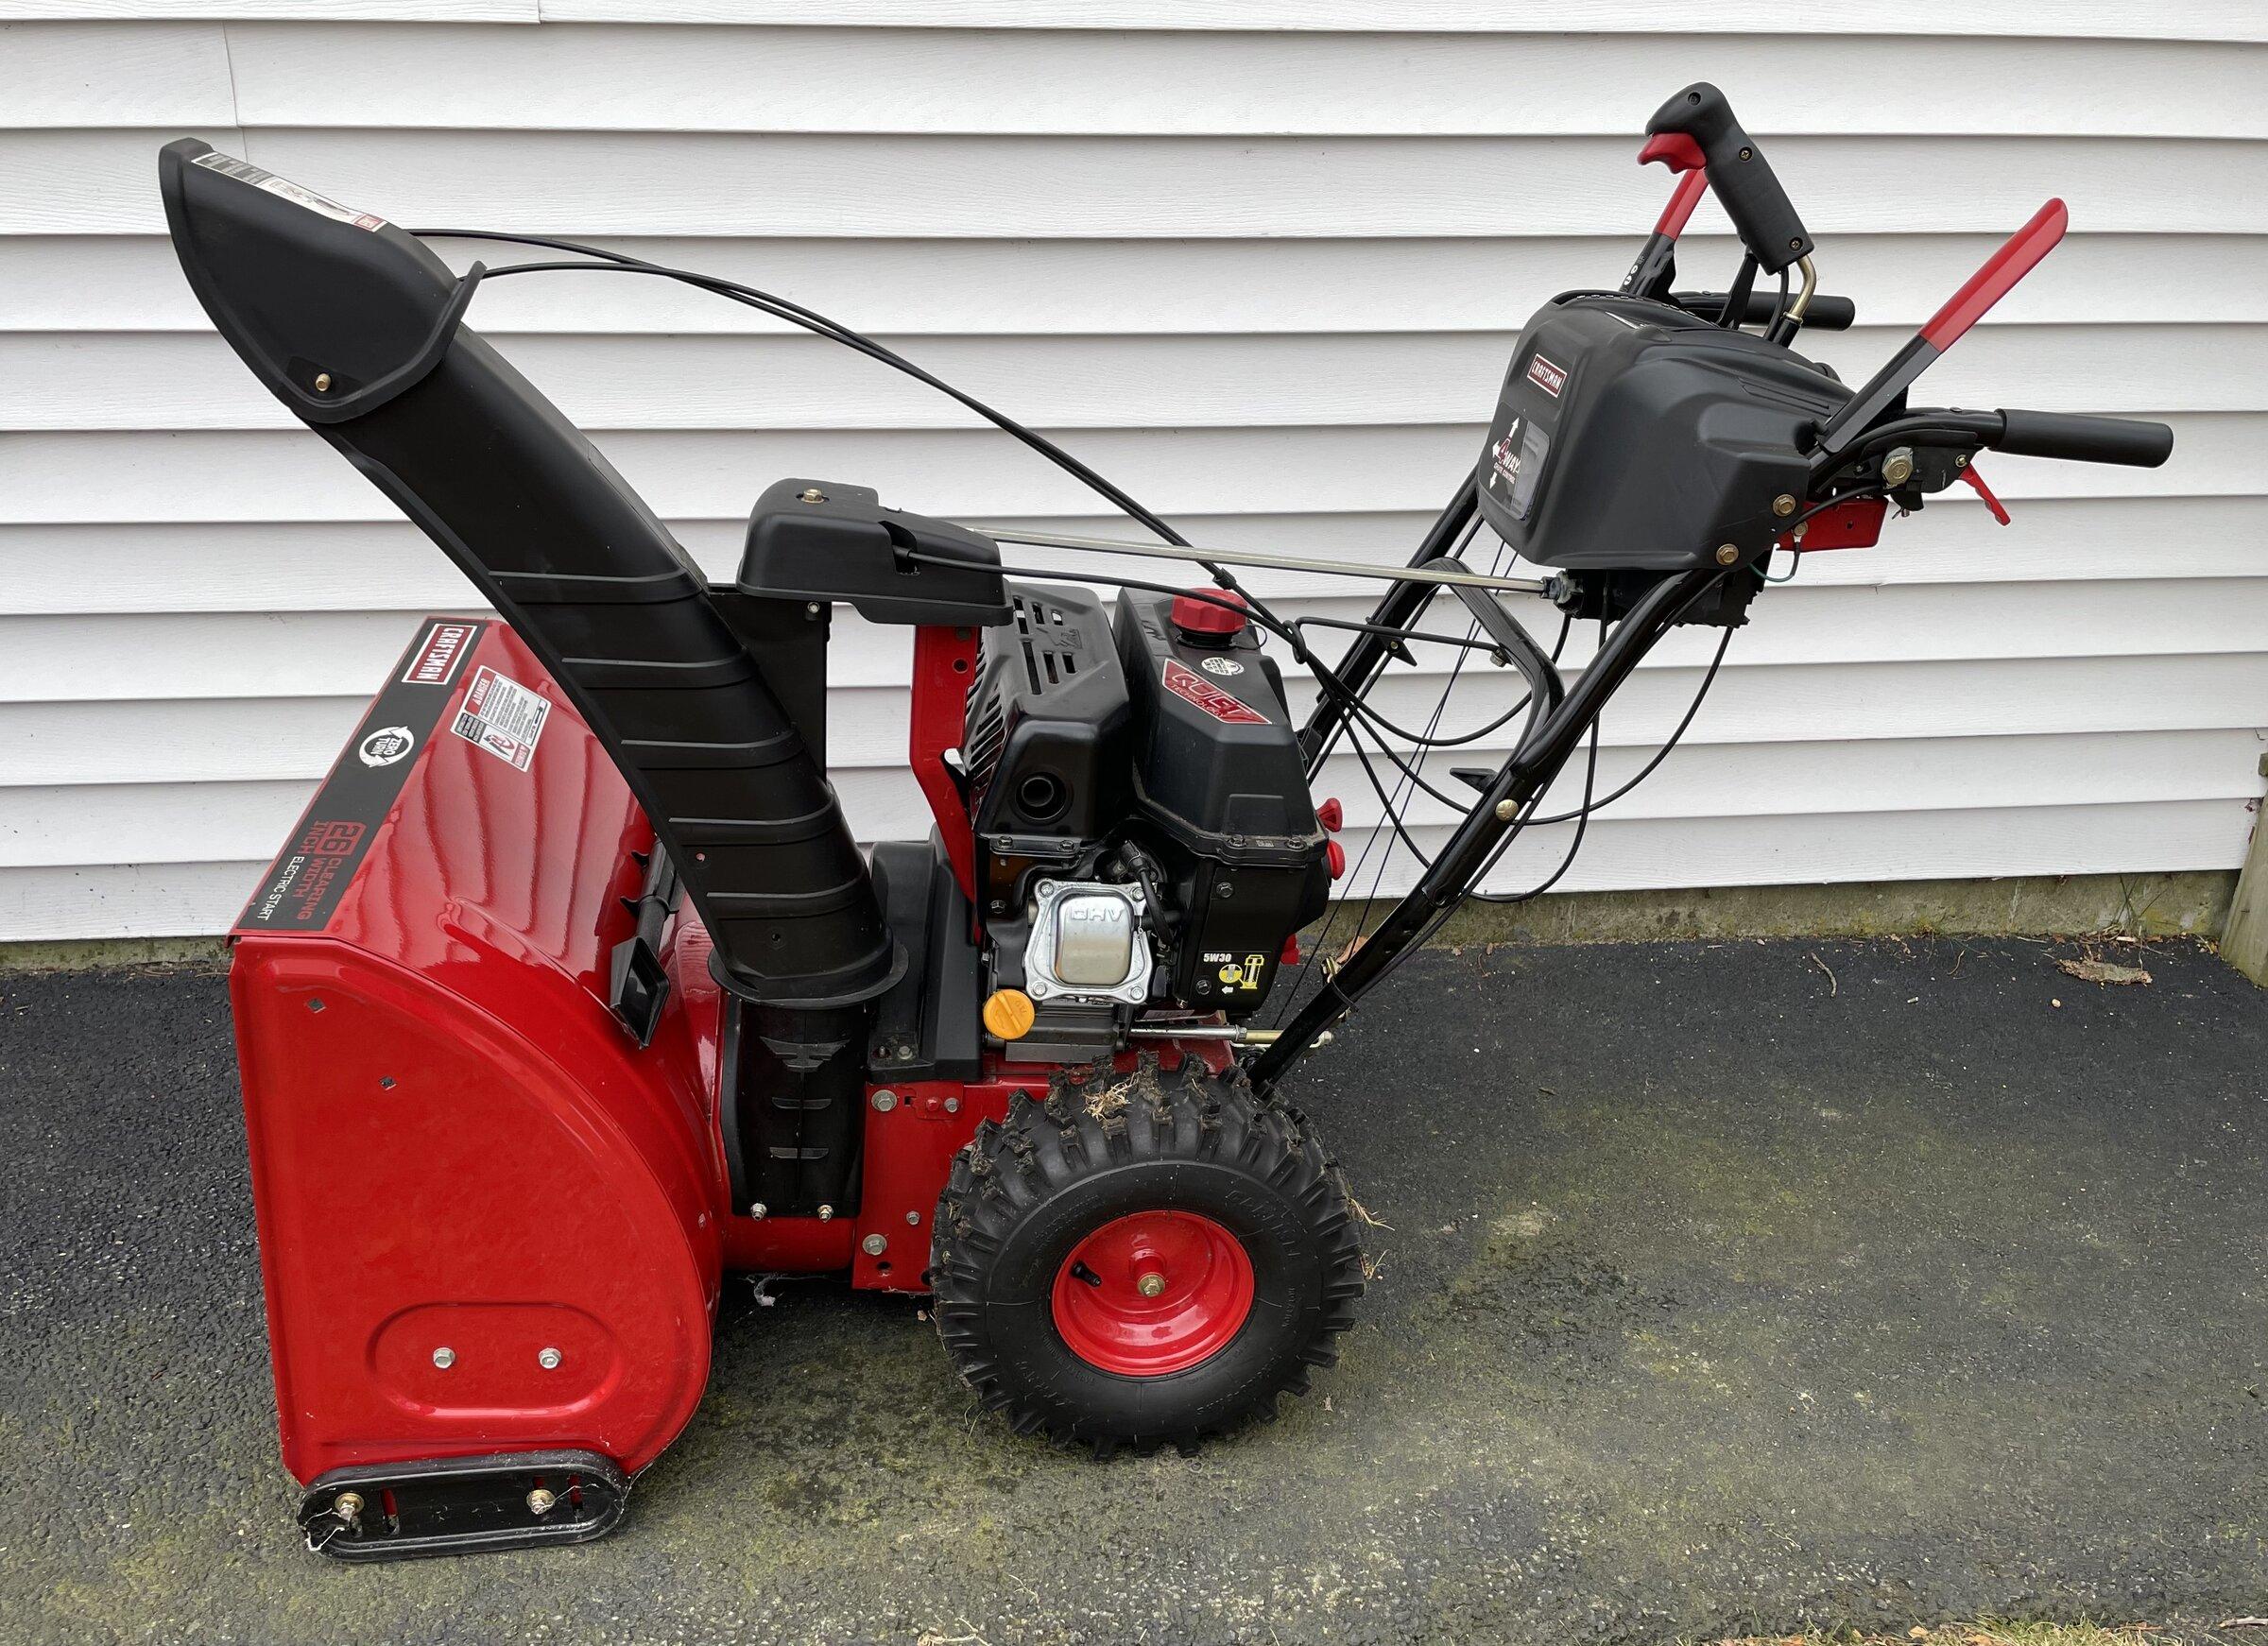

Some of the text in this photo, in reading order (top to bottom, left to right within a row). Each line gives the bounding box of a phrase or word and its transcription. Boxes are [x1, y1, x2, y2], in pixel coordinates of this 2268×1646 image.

[1531, 361, 1562, 390] CRAFTSMAN
[416, 627, 465, 680] CRAFTSMAN
[1172, 674, 1251, 714] QUIET
[1172, 683, 1227, 718] TECHNOLOGY
[383, 738, 403, 756] ZERO
[297, 820, 329, 854] INCH
[320, 824, 360, 851] 26
[257, 856, 304, 921] ELECTRIC START
[292, 857, 327, 898] WIDTH
[297, 858, 342, 920] CLEARING
[1071, 906, 1124, 922] OHV
[1203, 952, 1232, 963] 5W30
